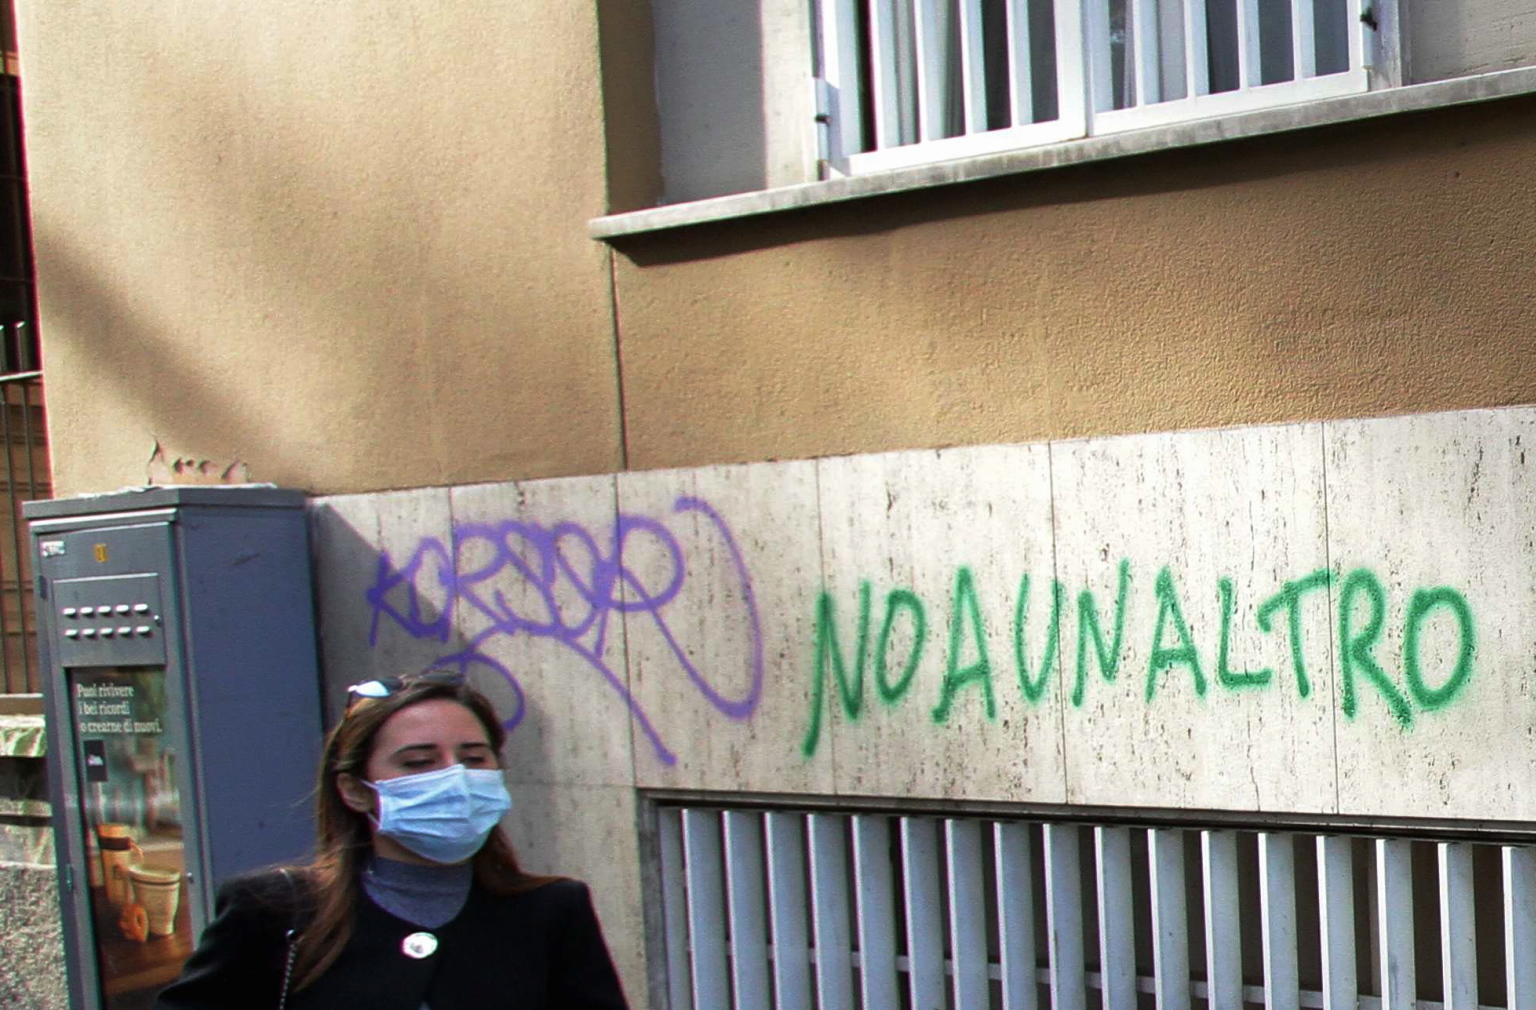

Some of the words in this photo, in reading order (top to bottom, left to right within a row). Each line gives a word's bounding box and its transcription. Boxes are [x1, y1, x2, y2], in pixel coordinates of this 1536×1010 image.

[77, 683, 98, 698] Puoi
[99, 682, 135, 698] rivivere
[84, 701, 98, 715] bei
[99, 700, 131, 715] ricordi
[88, 721, 122, 733] crearne
[123, 718, 134, 733] di
